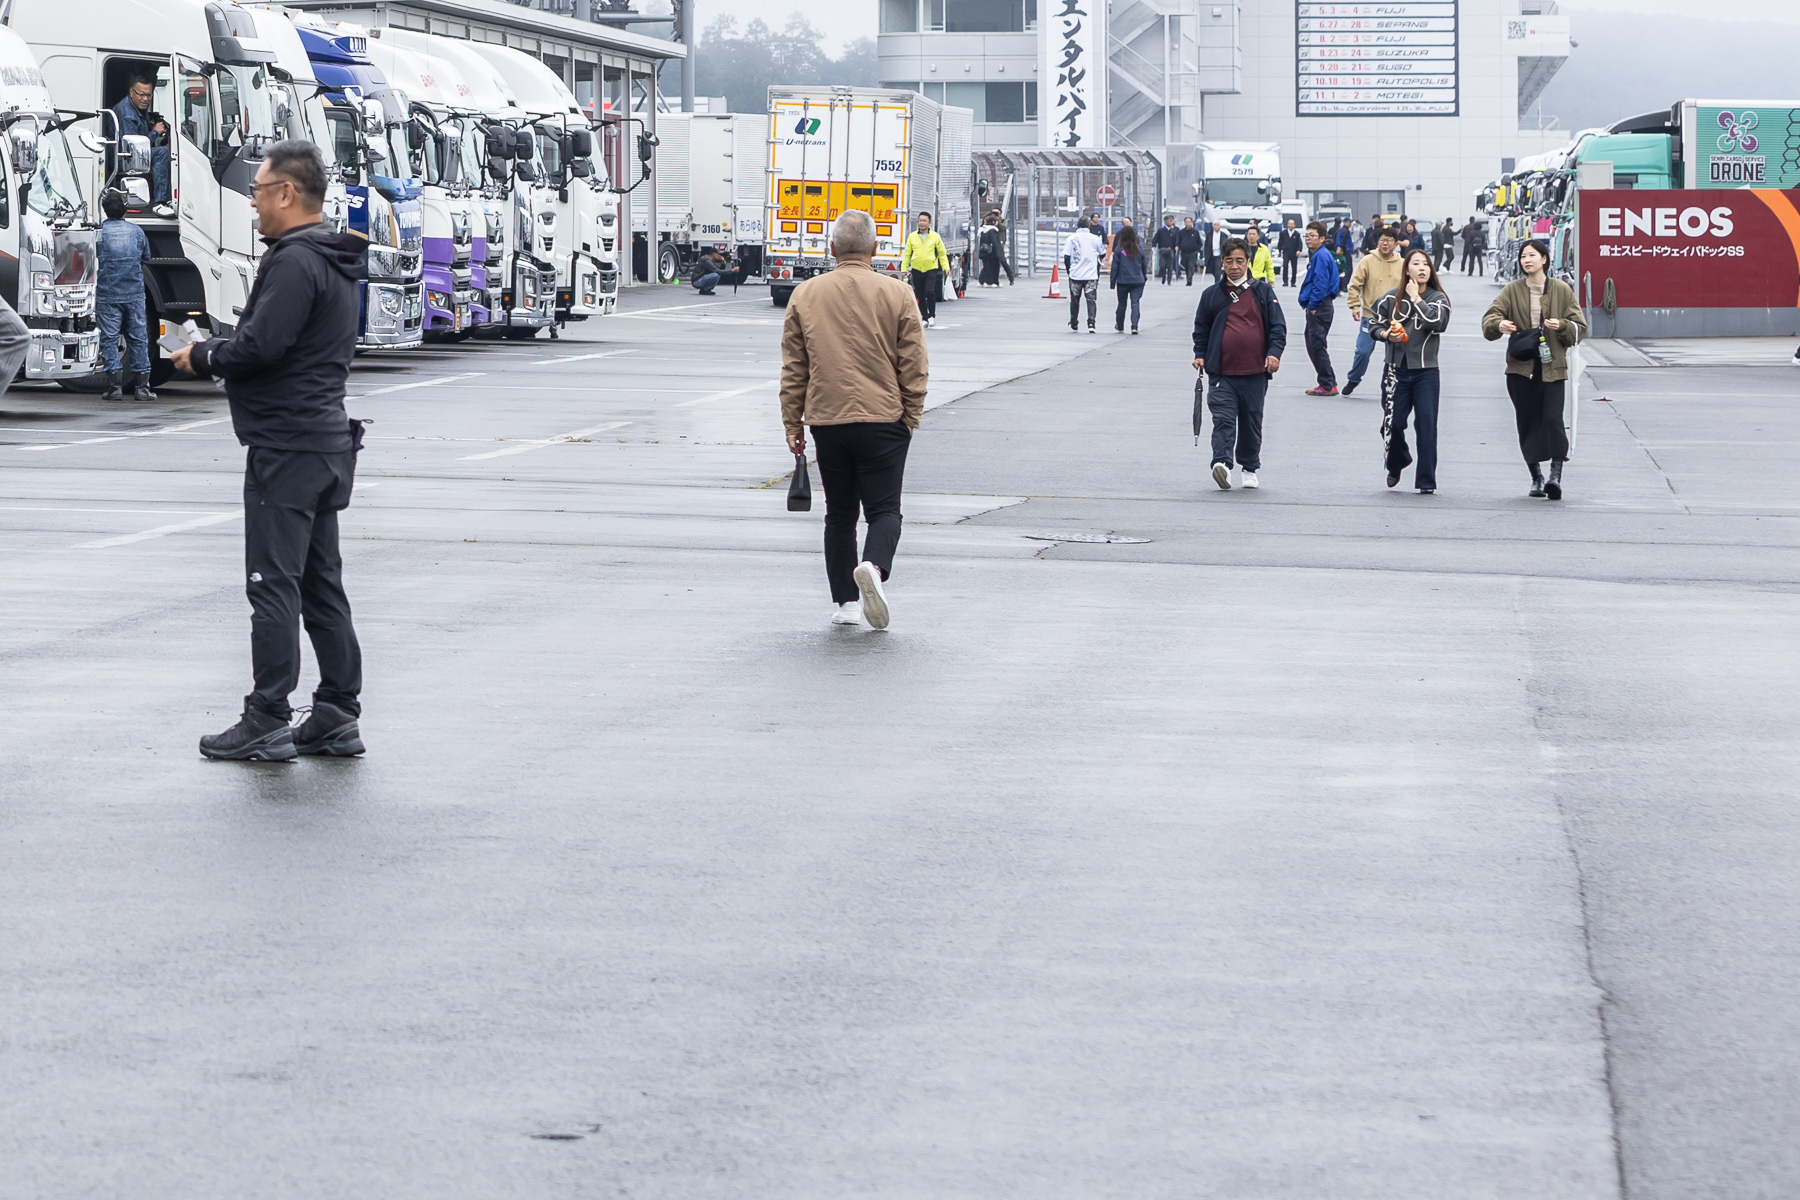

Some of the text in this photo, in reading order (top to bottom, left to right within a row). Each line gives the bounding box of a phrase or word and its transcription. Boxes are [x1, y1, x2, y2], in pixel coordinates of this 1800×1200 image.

[1351, 49, 1361, 57] 24
[1351, 63, 1362, 71] 21
[1351, 77, 1362, 85] 19
[1353, 91, 1359, 99] 2
[875, 159, 902, 172] 7552
[1232, 168, 1254, 176] 2579
[1710, 162, 1765, 181] DRONE
[781, 205, 800, 216] 全長
[809, 205, 821, 216] 25
[829, 208, 839, 218] m
[874, 209, 893, 220] 注意
[1598, 206, 1734, 238] ENEOS
[702, 224, 721, 234] 3160
